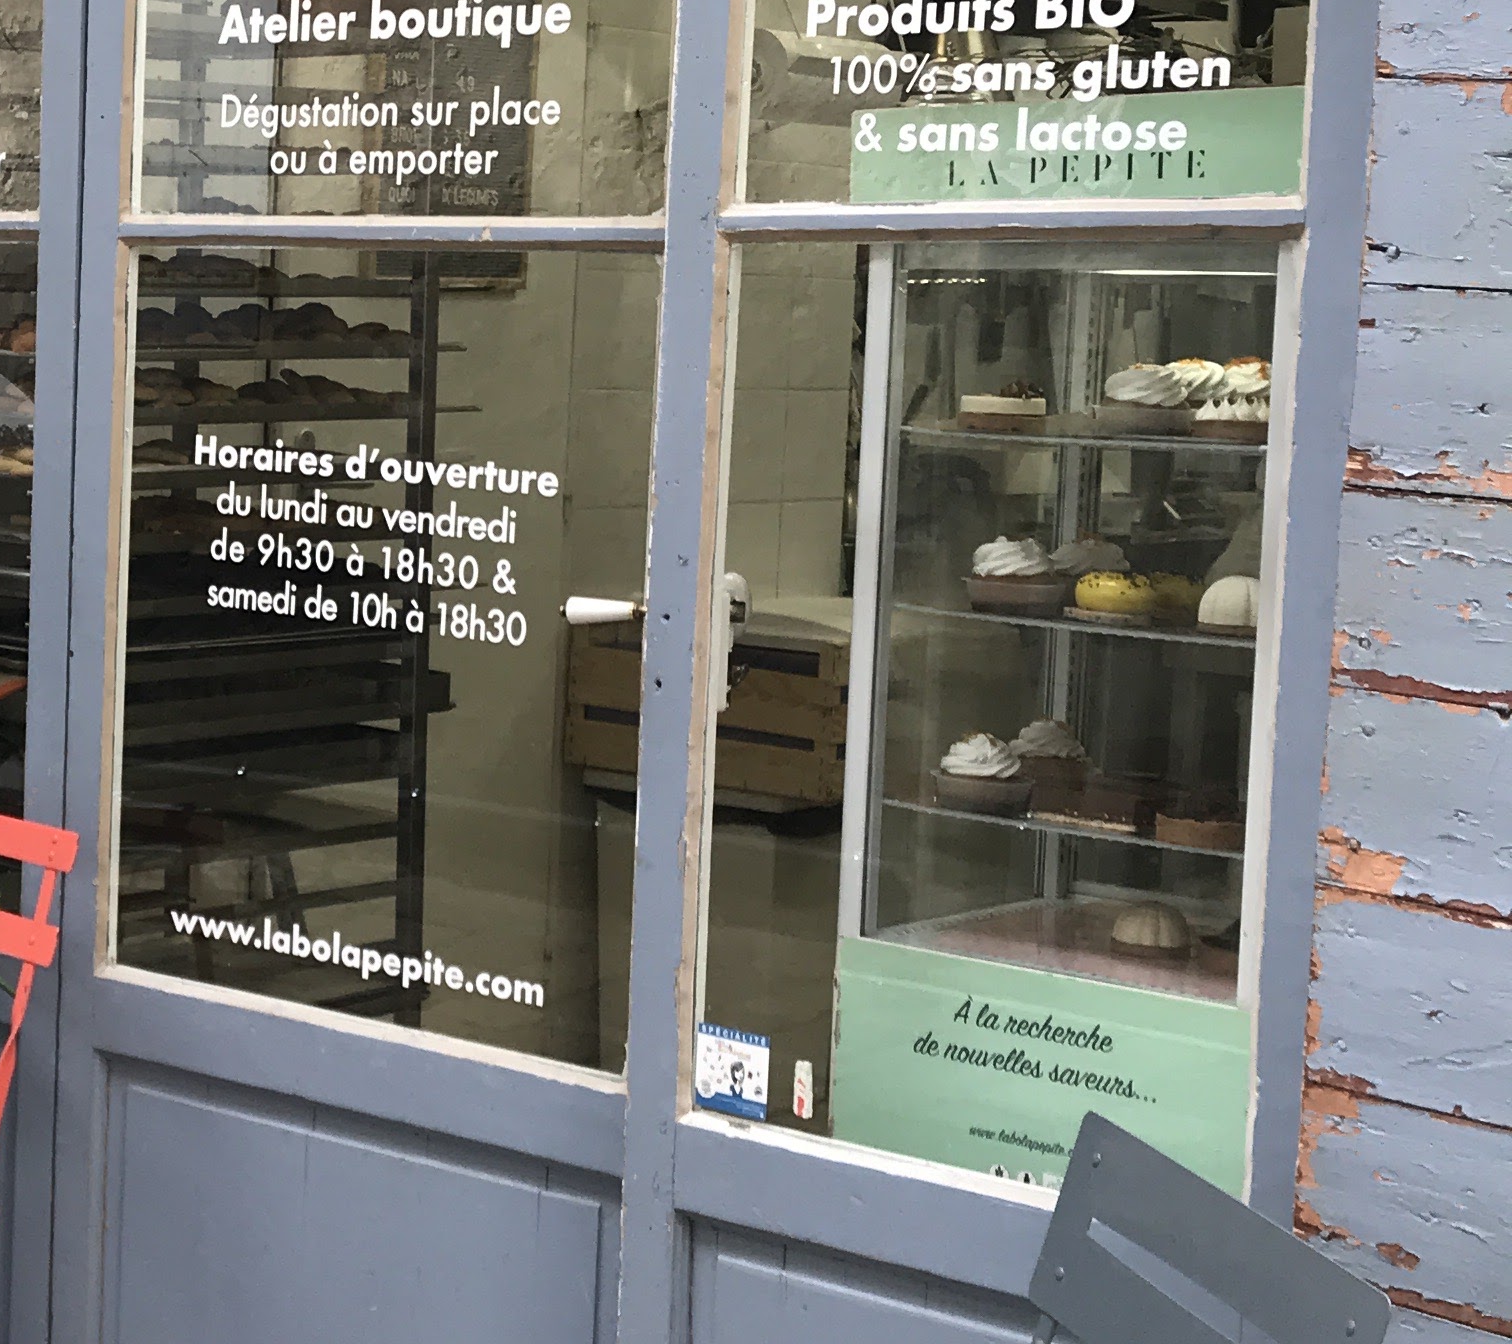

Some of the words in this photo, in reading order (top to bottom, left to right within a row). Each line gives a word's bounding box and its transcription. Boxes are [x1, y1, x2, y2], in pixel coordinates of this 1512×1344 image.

[829, 54, 938, 95] 100%
[951, 60, 1058, 94] sans
[1072, 45, 1232, 103] gluten
[220, 92, 398, 138] Dégustation
[410, 99, 459, 127] sur
[469, 85, 561, 137] place
[854, 112, 882, 153] &
[897, 119, 1000, 153] sans
[1015, 108, 1188, 151] lactose
[270, 149, 308, 175] ou
[318, 139, 337, 175] à
[349, 142, 499, 186] emporter
[944, 155, 1000, 187] LA
[1029, 149, 1208, 185] PEPITE
[194, 434, 334, 478] Horaires
[216, 481, 251, 517] du
[260, 484, 328, 525] lundi
[336, 504, 374, 530] au
[383, 501, 517, 544] vendredi
[211, 528, 245, 561] de
[257, 534, 334, 572] 9h30
[346, 546, 364, 577] à
[381, 547, 478, 590] 18h30
[492, 558, 517, 595] &
[207, 580, 297, 617] samedi
[304, 585, 338, 621] de
[350, 592, 397, 629] 10h
[405, 601, 424, 634] à
[438, 602, 528, 647] 18h30
[170, 909, 545, 1008] www.labolapepite.com
[953, 995, 974, 1024] À
[976, 1004, 1000, 1031] la
[1003, 1014, 1114, 1053] recherche
[913, 1031, 940, 1056] de
[943, 1042, 1043, 1079] nouvelles
